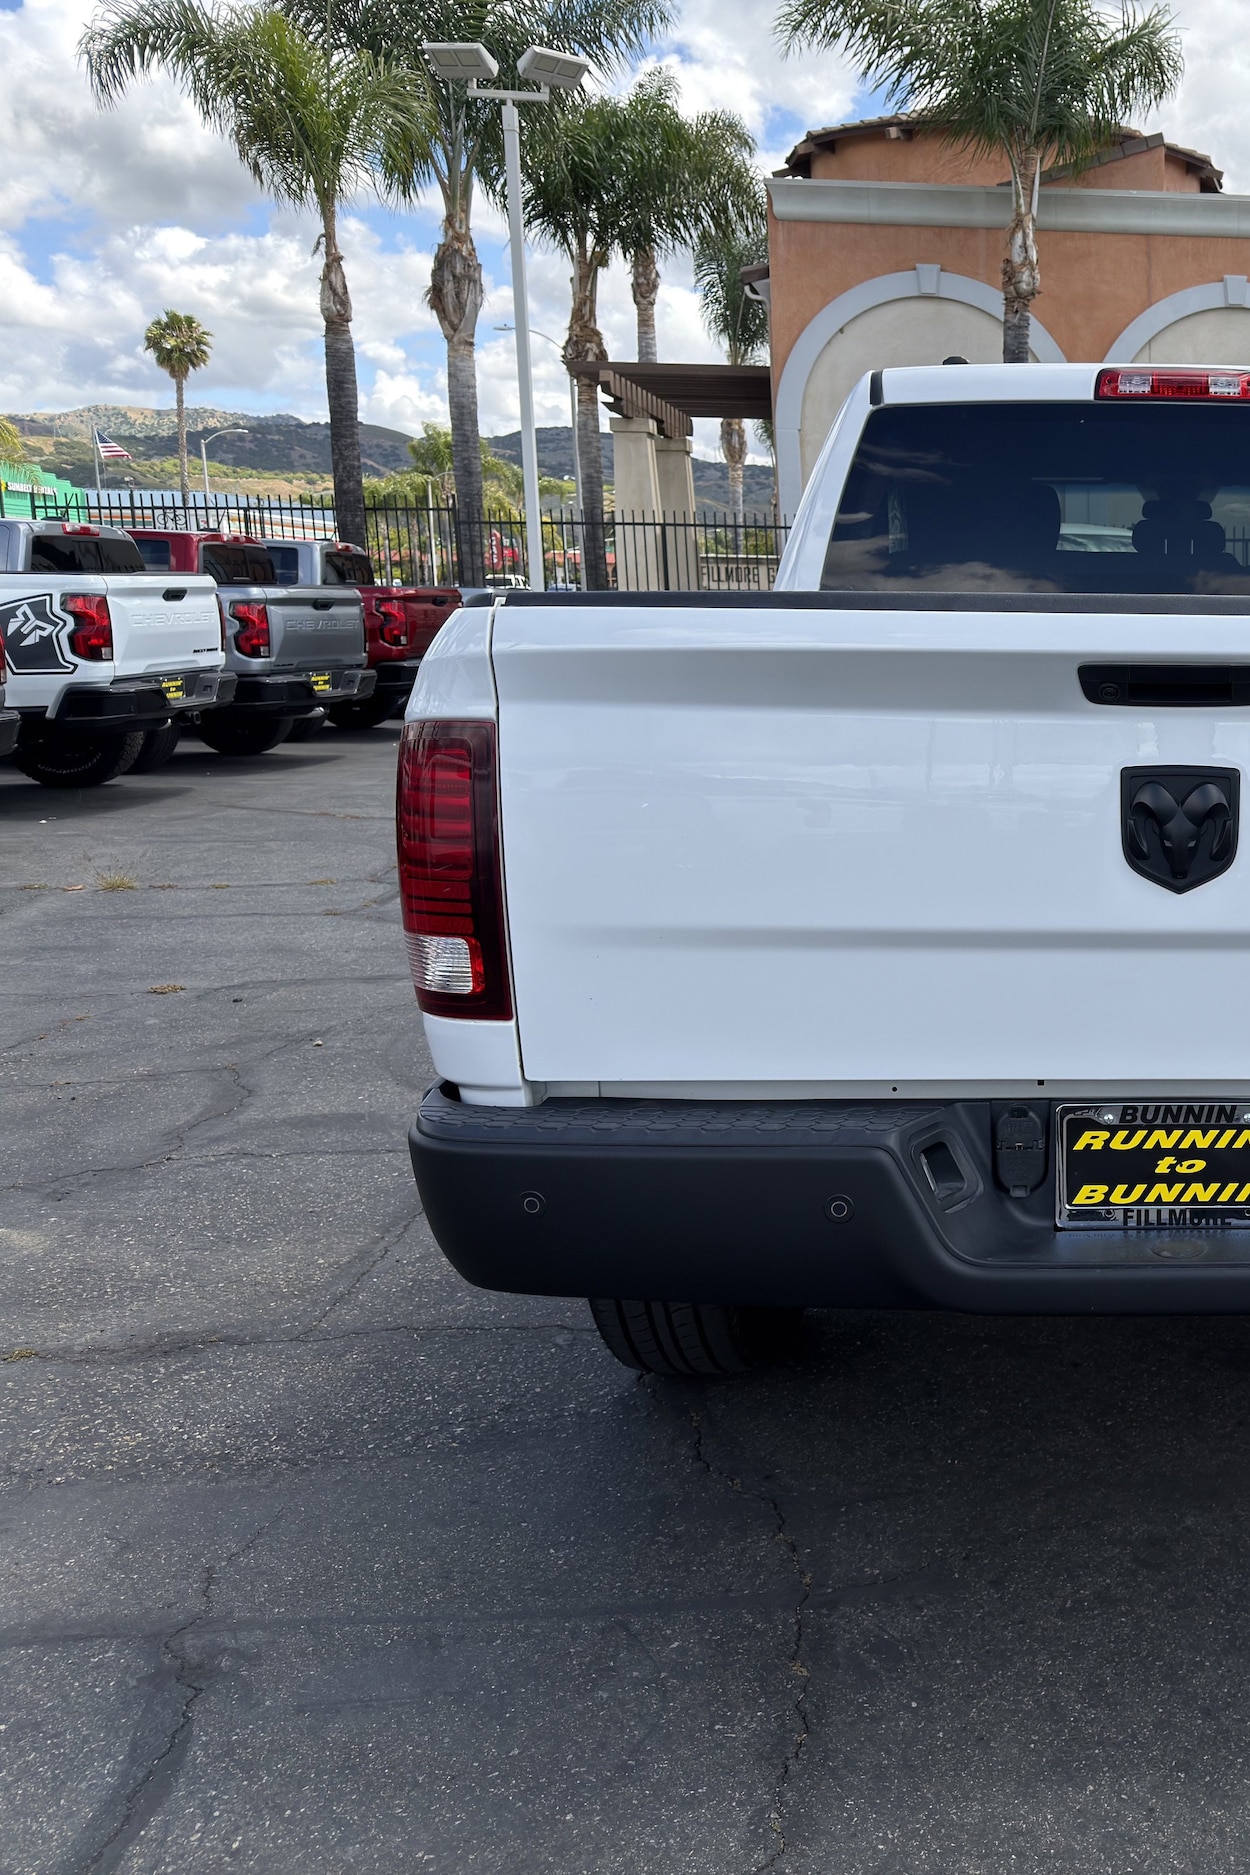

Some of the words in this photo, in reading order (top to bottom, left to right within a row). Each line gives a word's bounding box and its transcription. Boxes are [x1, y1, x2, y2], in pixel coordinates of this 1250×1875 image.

[701, 566, 760, 583] FLLMORE
[131, 611, 216, 627] CHEVROLET
[1119, 1105, 1236, 1124] BUNNIN
[1154, 1156, 1207, 1174] to
